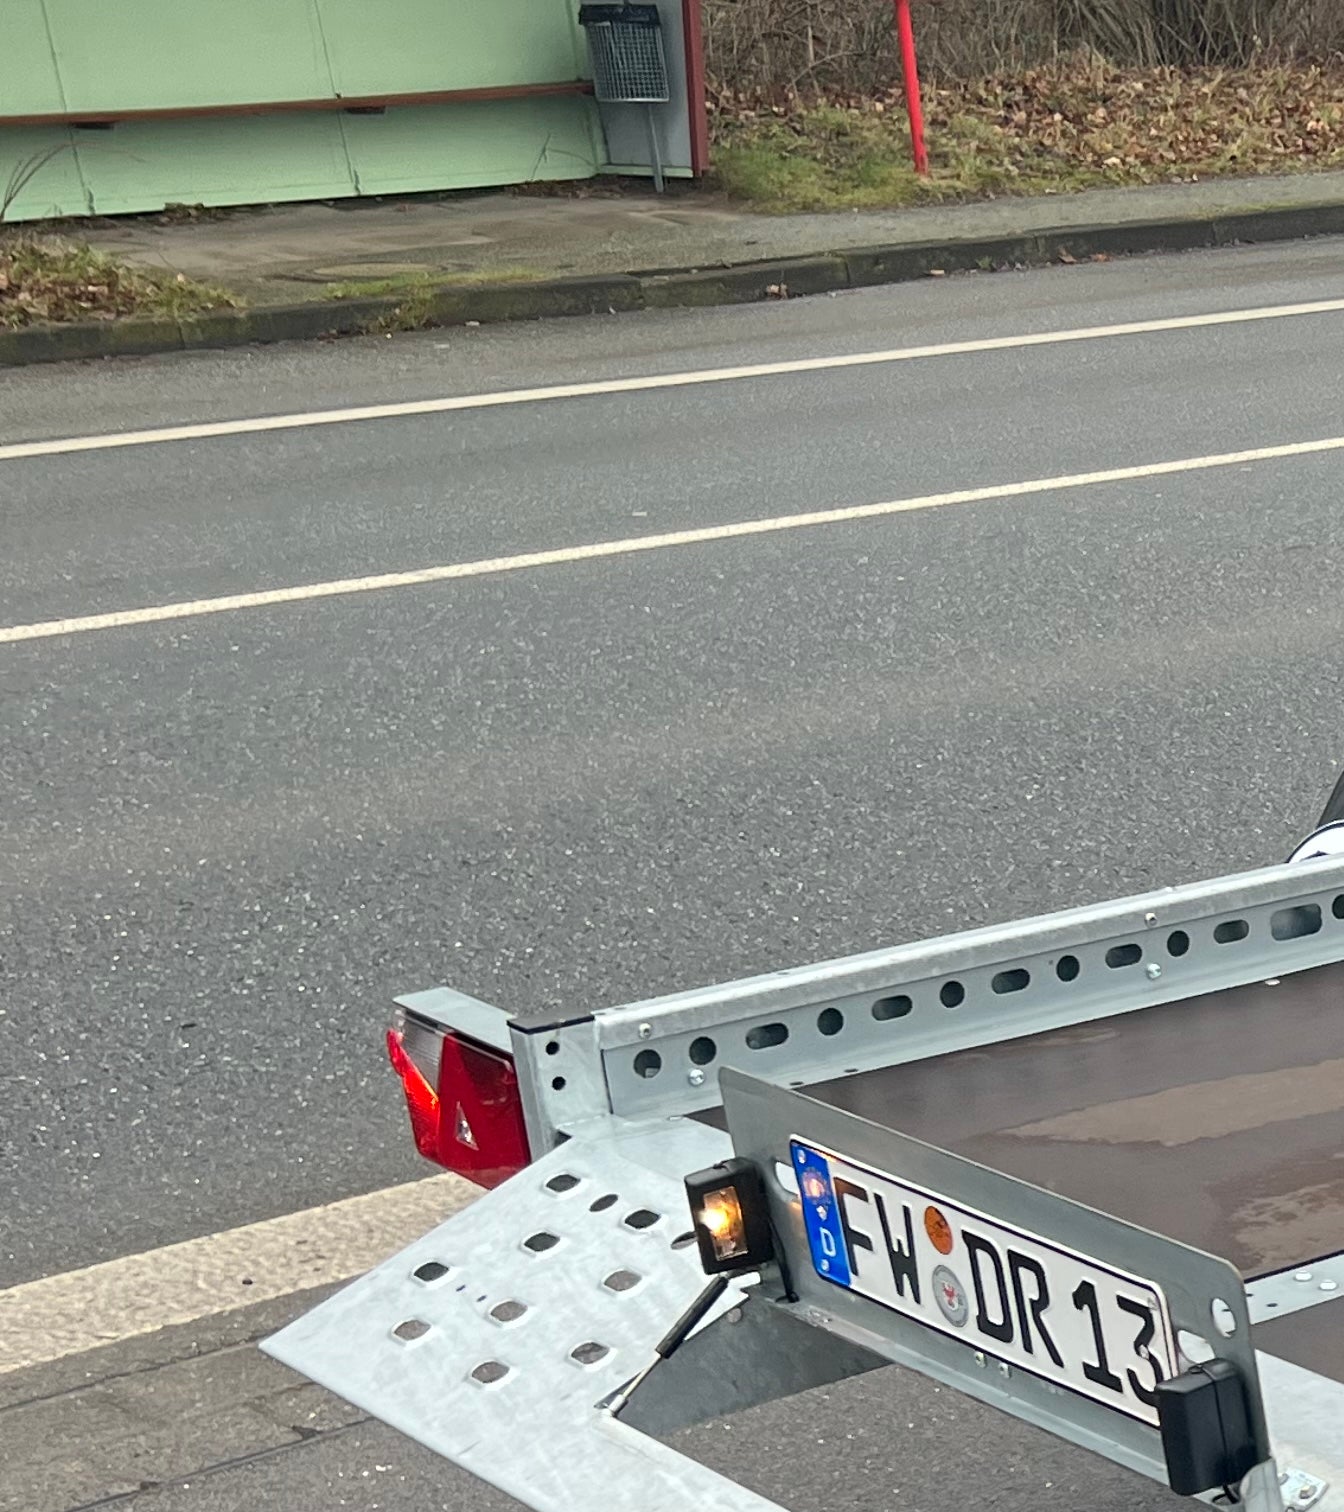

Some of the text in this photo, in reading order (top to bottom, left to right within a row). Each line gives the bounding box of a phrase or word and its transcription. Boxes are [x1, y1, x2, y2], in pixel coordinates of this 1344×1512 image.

[817, 1225, 838, 1258] D
[833, 1176, 1162, 1406] FW DR 13
